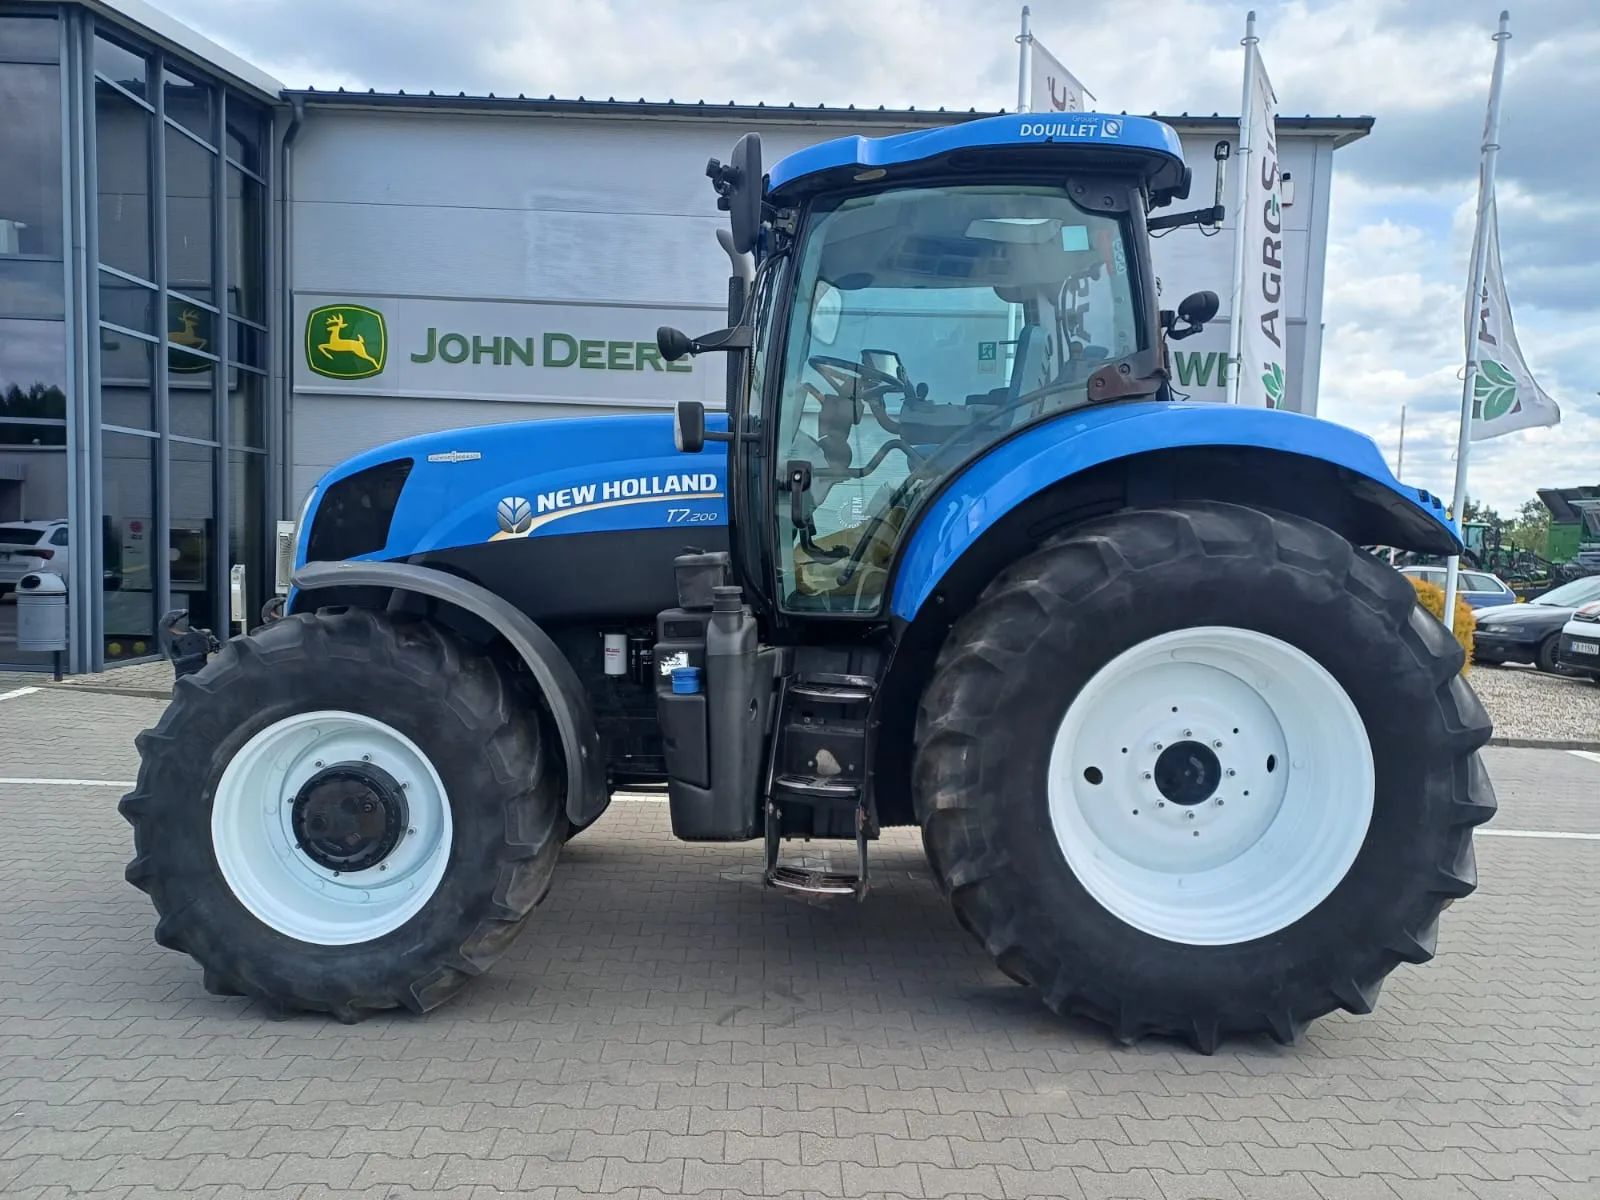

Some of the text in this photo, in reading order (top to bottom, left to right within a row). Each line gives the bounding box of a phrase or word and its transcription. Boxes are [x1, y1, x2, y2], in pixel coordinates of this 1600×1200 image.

[1020, 123, 1098, 137] DOUILLET
[410, 328, 534, 366] JOHN
[537, 473, 718, 513] NEW HOLLAND
[666, 508, 718, 523] T7.200
